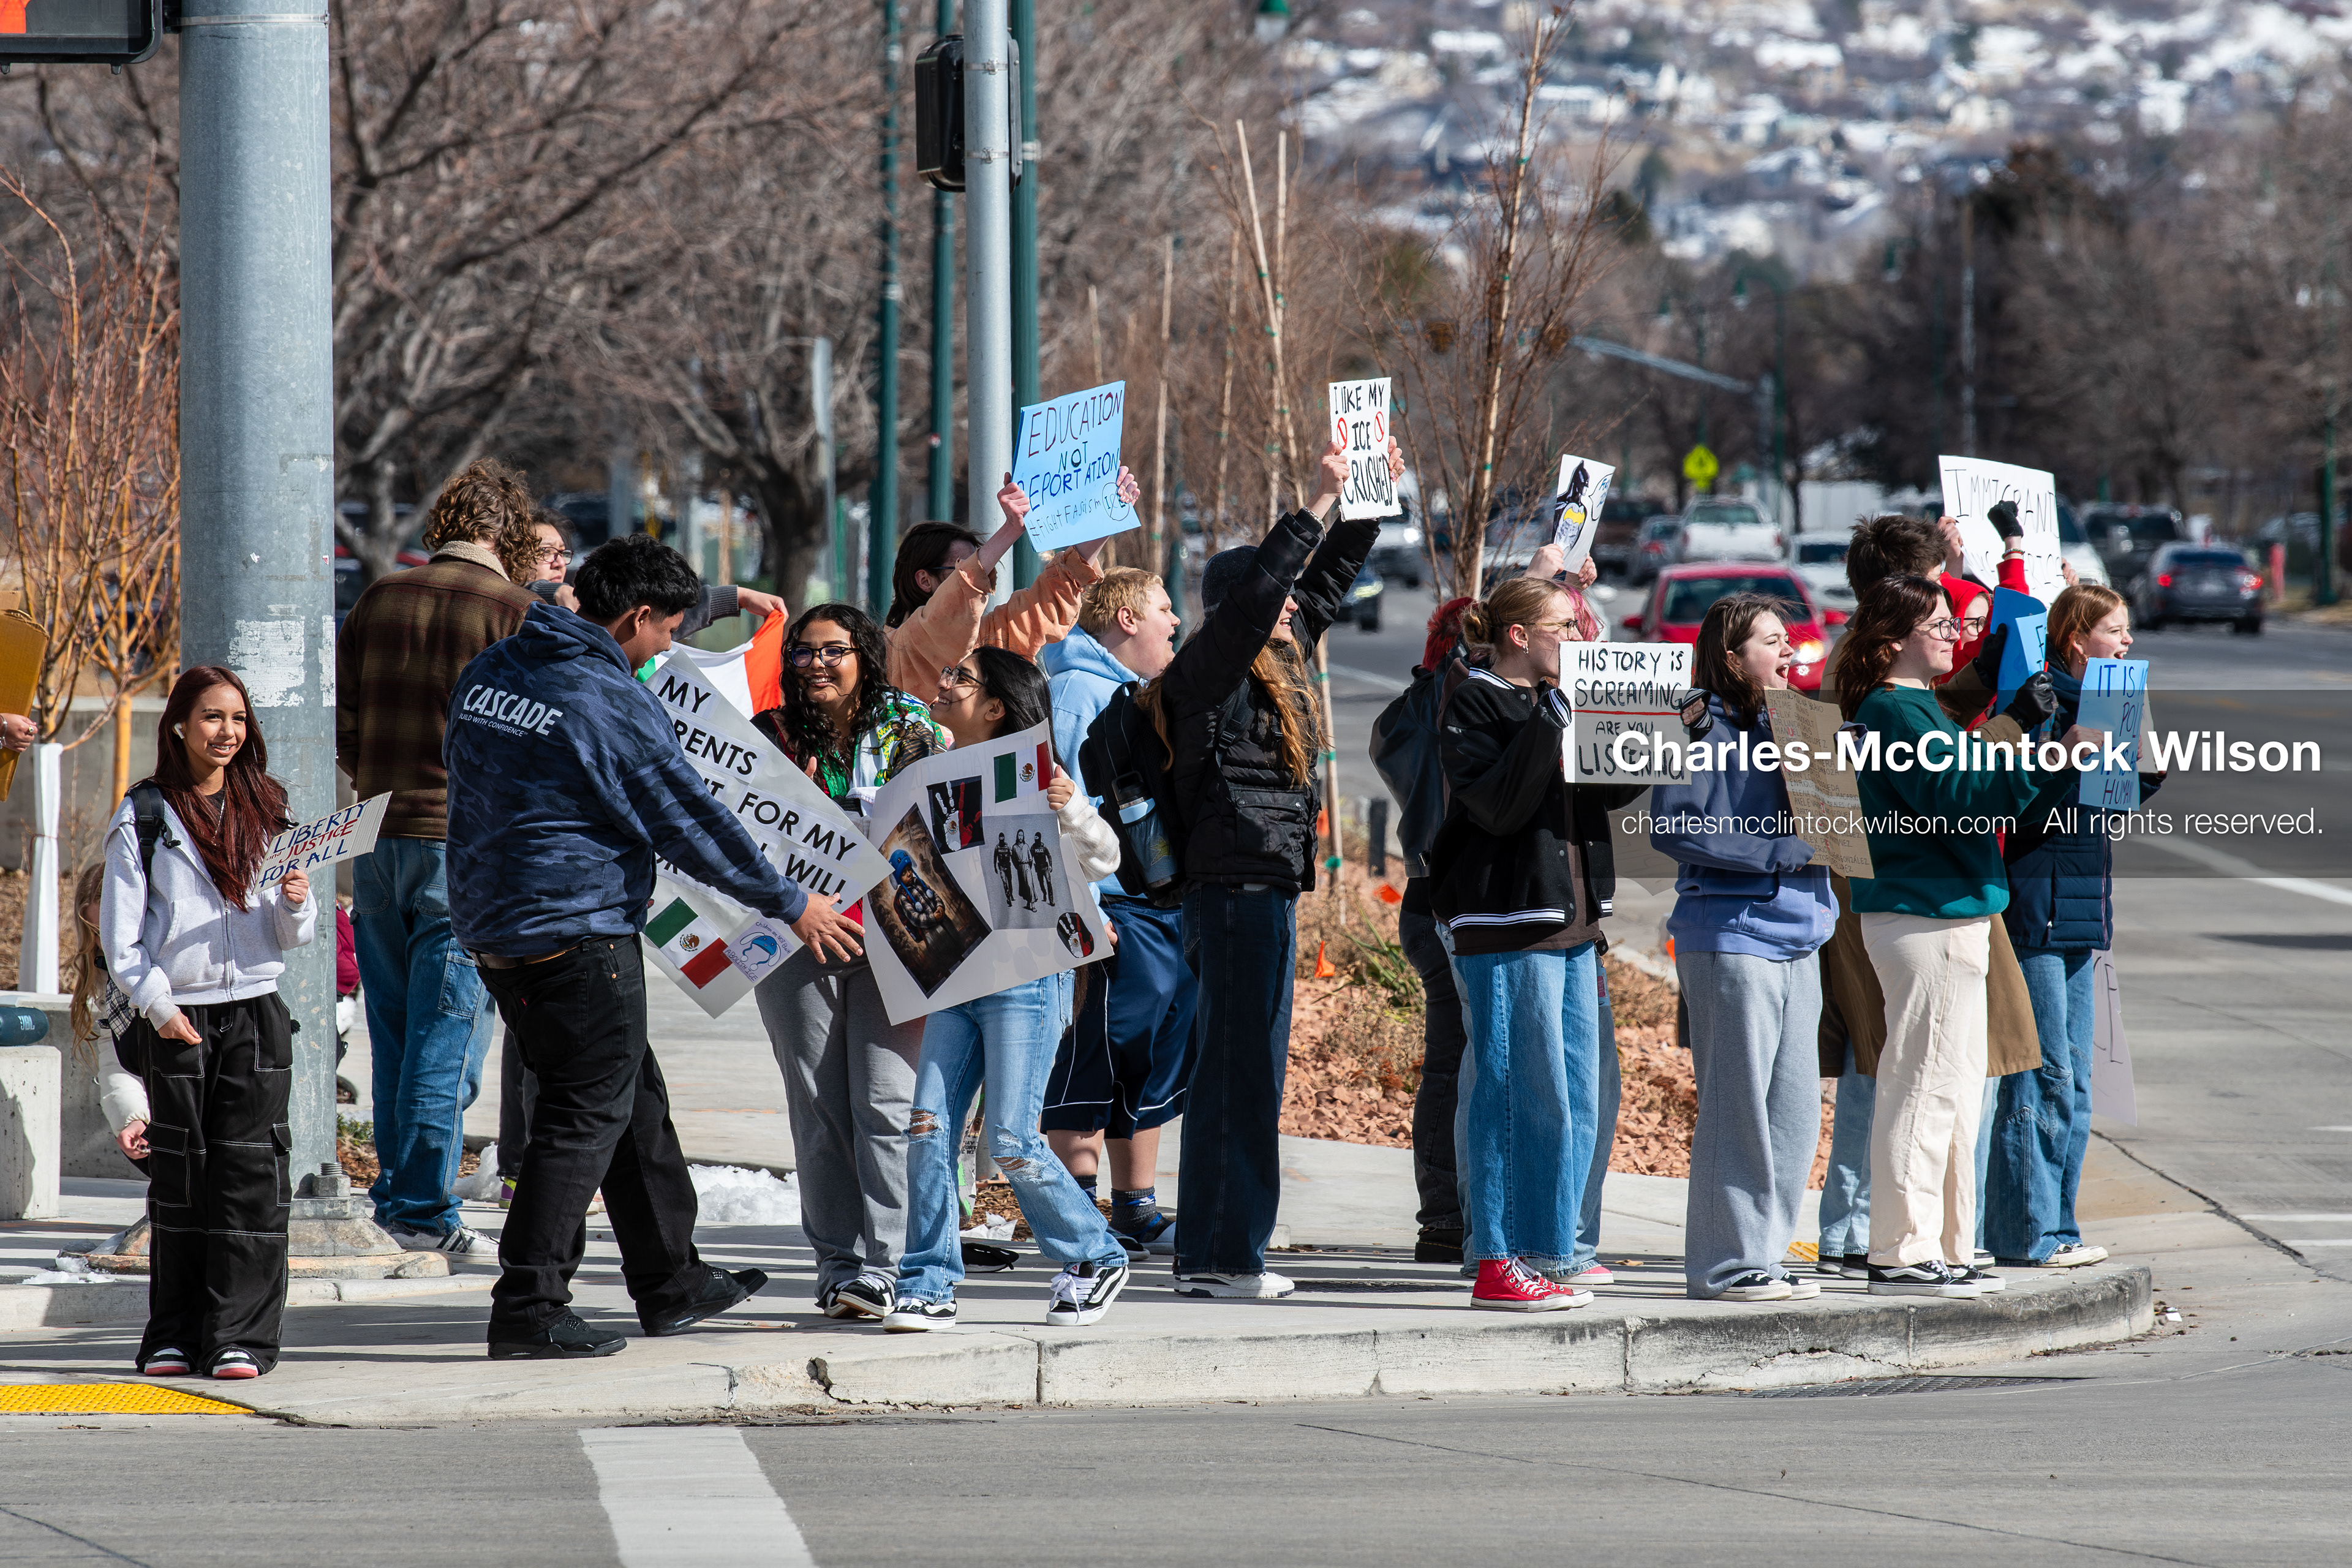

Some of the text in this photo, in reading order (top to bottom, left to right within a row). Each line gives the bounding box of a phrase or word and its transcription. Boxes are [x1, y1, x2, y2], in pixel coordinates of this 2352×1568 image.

[1333, 386, 1338, 415] I
[1368, 382, 1384, 407] MY
[1028, 390, 1123, 458] EDUCATION
[1351, 420, 1371, 451] ICE
[1058, 441, 1088, 473] NOT
[1578, 647, 1662, 678] HISTORY
[657, 674, 712, 714] MY
[1575, 678, 1683, 710] SCREAMING
[2097, 665, 2117, 698] IT
[2122, 666, 2135, 698] IS
[463, 684, 564, 736] CASCADE
[472, 715, 488, 726] WITH
[488, 721, 524, 737] CONFIDENCE
[1769, 707, 1790, 719] FELIX
[1596, 720, 1654, 736] ARE YOU
[674, 718, 758, 775] RENTS
[266, 818, 358, 864] and JUSTICE
[273, 799, 372, 854] LIBERTY
[737, 791, 858, 862] FOR MY
[258, 839, 349, 888] FOR ALL
[784, 853, 846, 905] WILL
[777, 935, 786, 944] NOT
[725, 949, 758, 982] ABOLISH ICE
[17, 1014, 36, 1031] JBL
